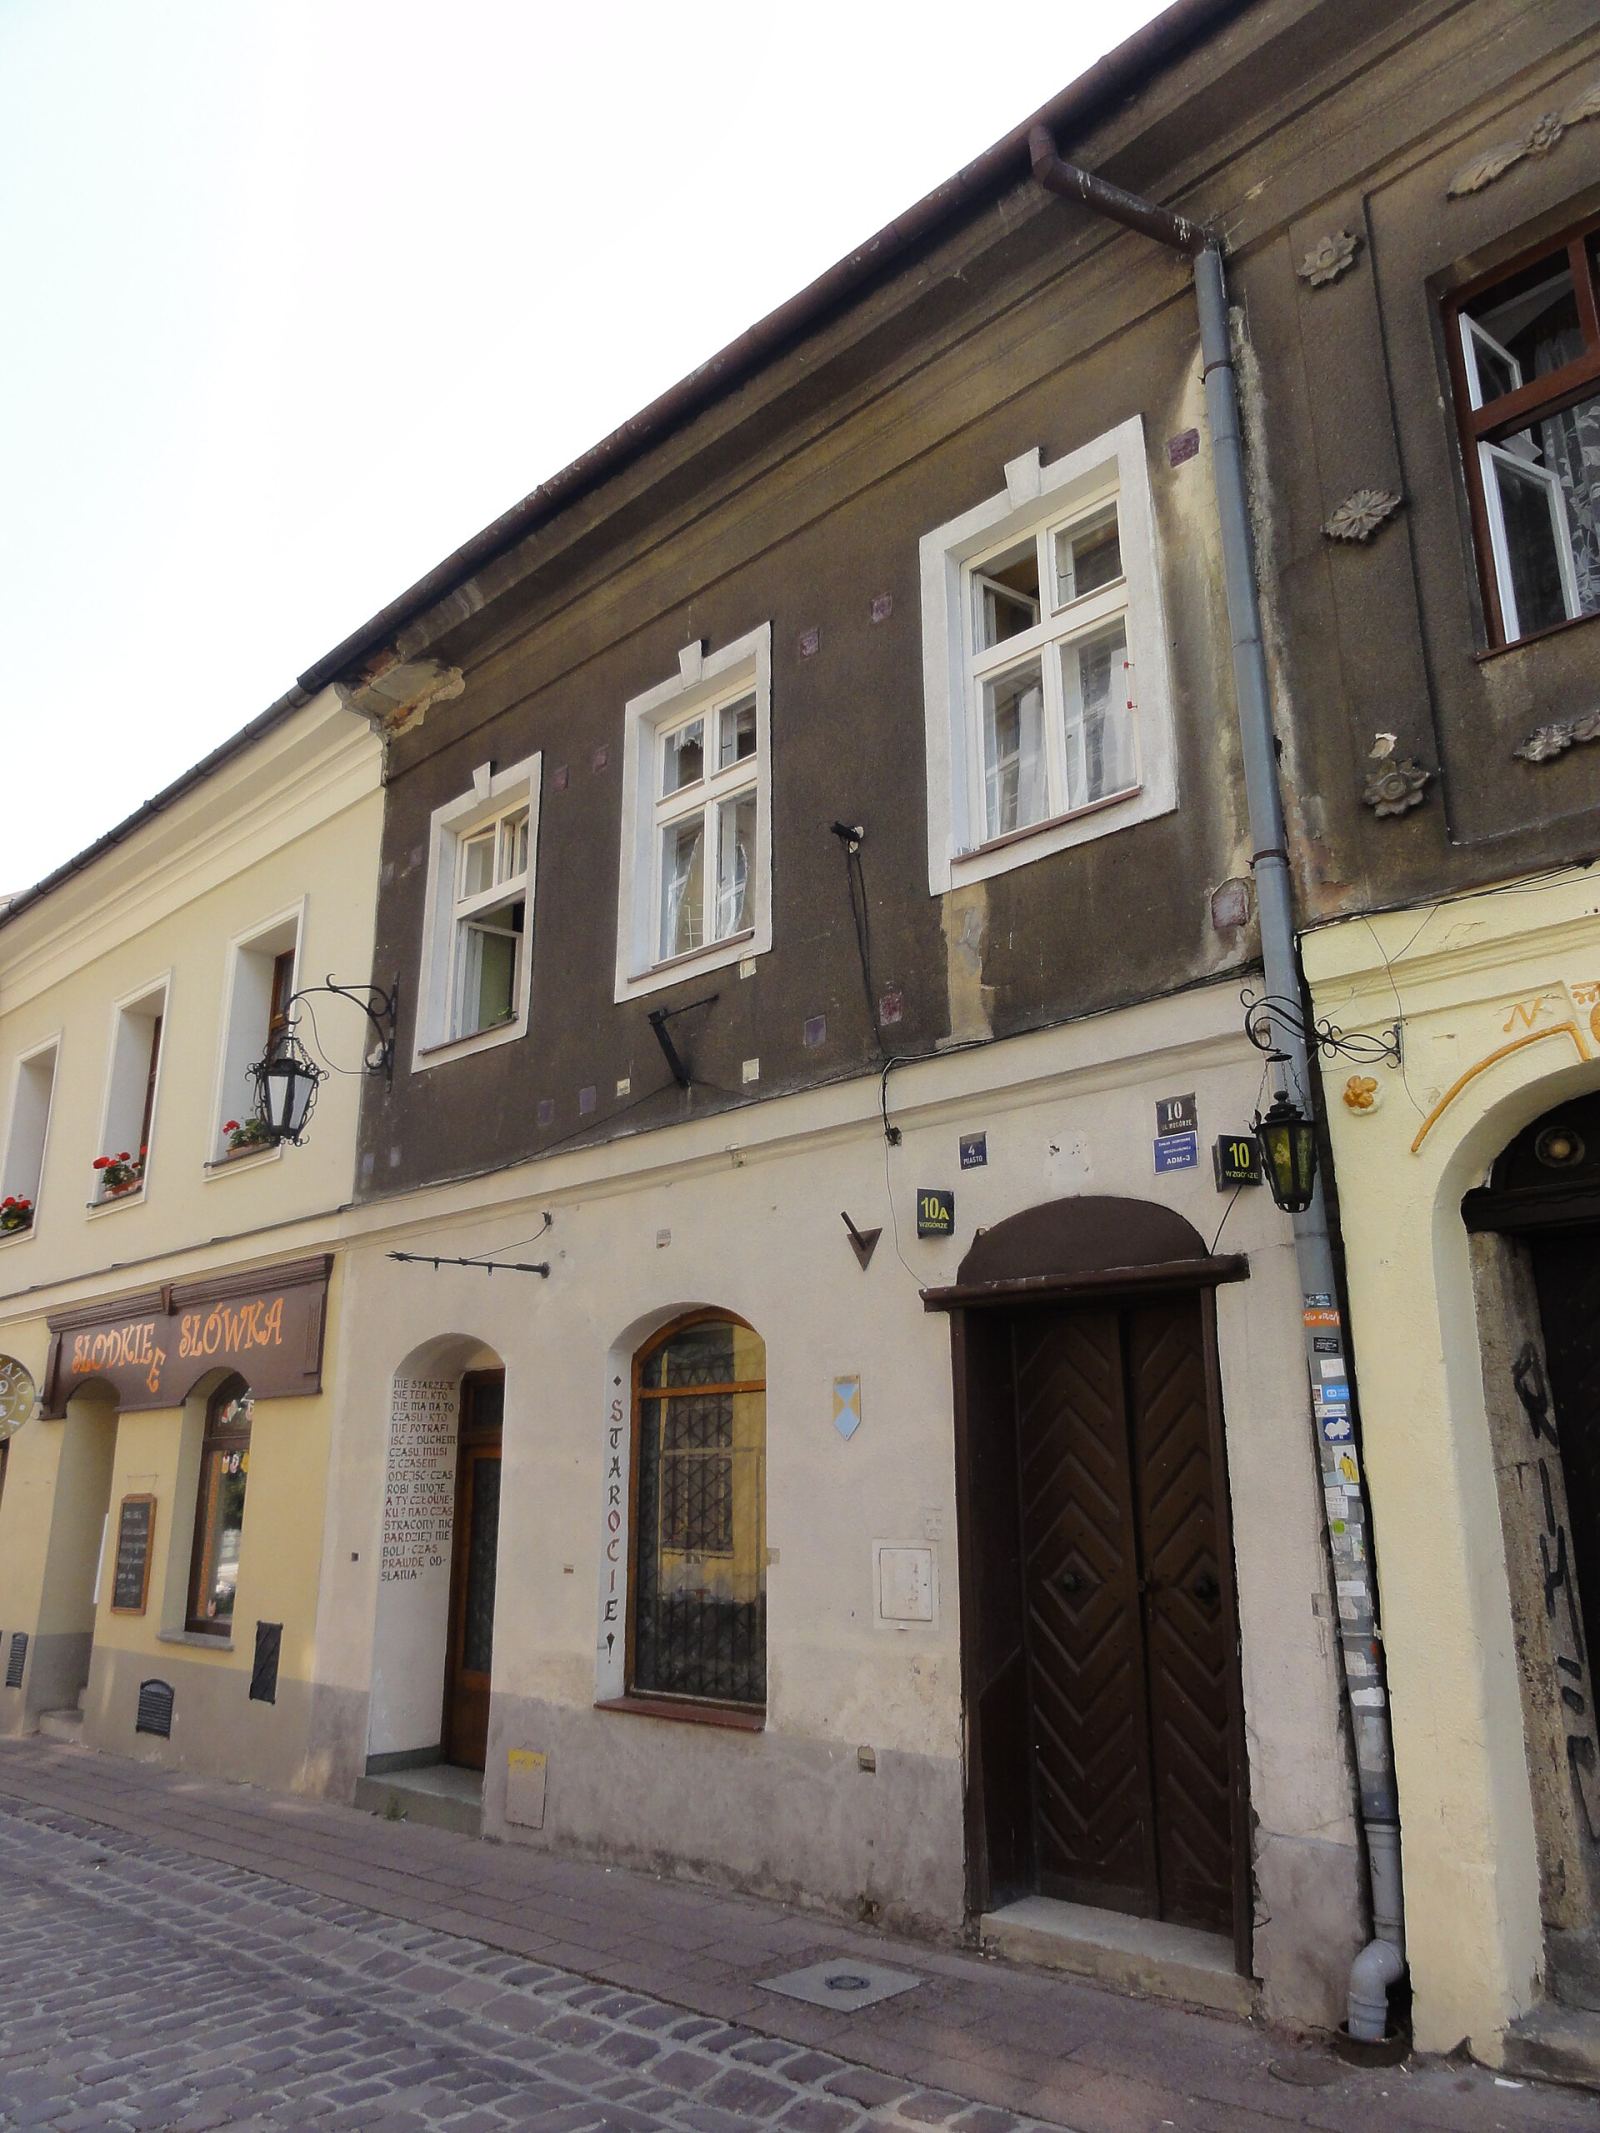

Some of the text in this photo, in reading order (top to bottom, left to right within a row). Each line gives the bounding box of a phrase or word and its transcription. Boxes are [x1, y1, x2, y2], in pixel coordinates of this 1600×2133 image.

[1166, 1101, 1182, 1121] 10
[968, 1144, 975, 1155] 4
[1229, 1142, 1250, 1168] 10
[963, 1155, 983, 1165] MIASTO
[1166, 1155, 1190, 1165] ADM-3
[921, 1197, 949, 1220] 10A
[431, 1391, 448, 1401] KTO
[393, 1401, 455, 1412] NIE MA NA TO
[392, 1423, 448, 1433] NIE POTRAFI
[417, 1435, 456, 1445] DUCHEM
[423, 1447, 447, 1457] MUSI
[388, 1458, 437, 1469] Z CZASEM
[430, 1470, 453, 1480] CZAS
[387, 1483, 409, 1494] ROBI
[386, 1496, 392, 1506] A
[396, 1496, 408, 1505] TY
[408, 1507, 428, 1517] NAD
[430, 1506, 453, 1516] CZAS
[603, 1399, 623, 1621] STAROCIE
[384, 1519, 435, 1531] STRACONY
[383, 1531, 450, 1543] BARDZIEJ NIE
[382, 1544, 438, 1557] BOLI CZAS
